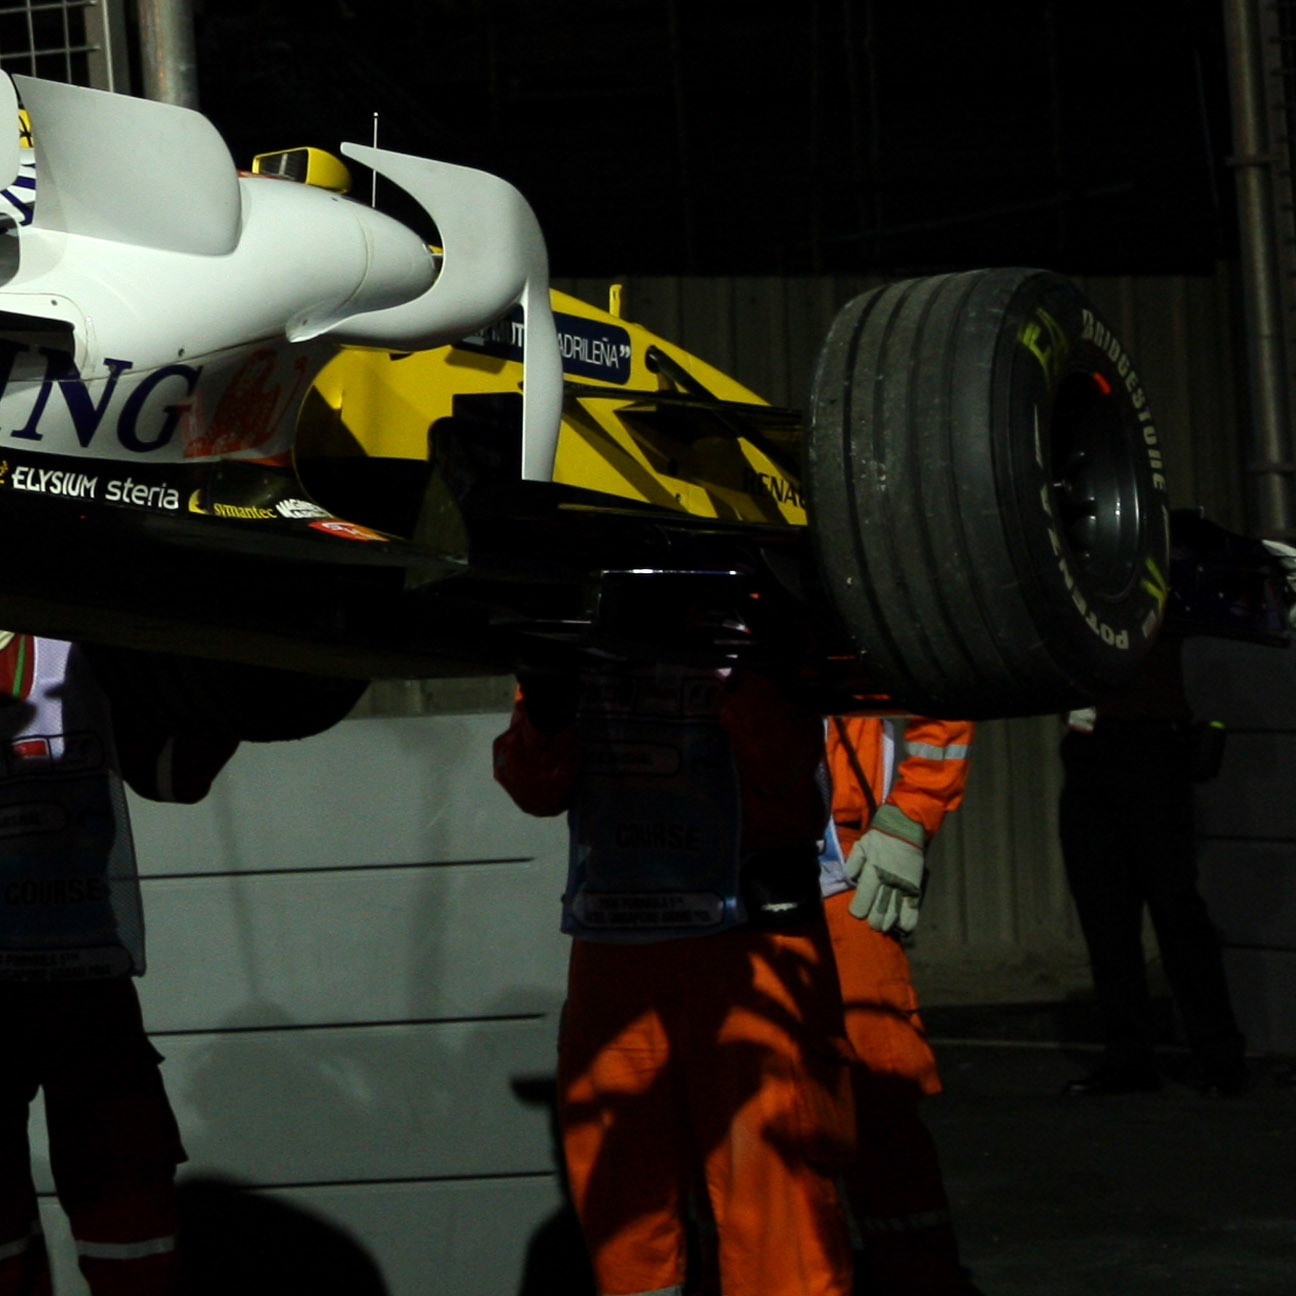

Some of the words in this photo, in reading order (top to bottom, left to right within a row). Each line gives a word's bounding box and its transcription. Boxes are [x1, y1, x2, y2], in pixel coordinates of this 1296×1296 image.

[12, 466, 99, 498] ELYSIUM
[105, 477, 180, 510] steria
[213, 502, 278, 520] symantec
[6, 878, 101, 905] COURSE
